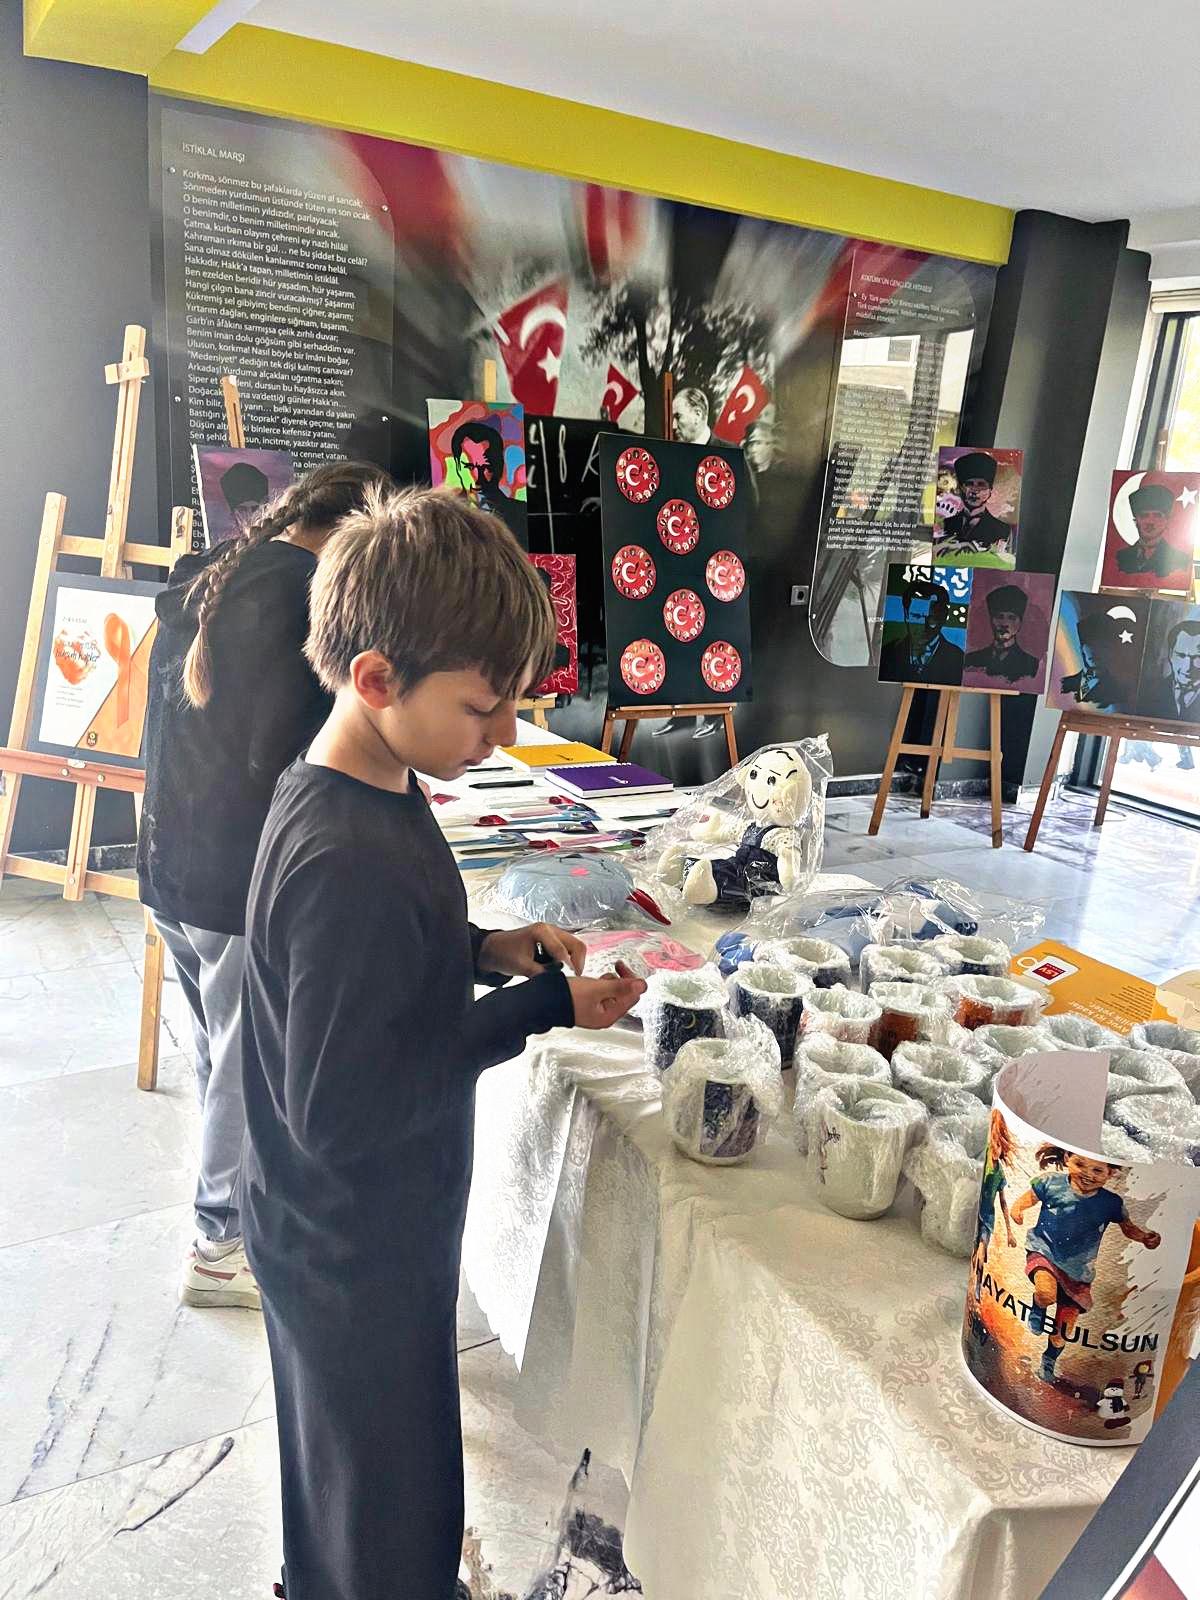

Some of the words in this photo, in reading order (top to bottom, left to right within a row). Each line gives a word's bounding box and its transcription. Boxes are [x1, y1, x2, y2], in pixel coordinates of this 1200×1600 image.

[183, 194, 190, 203] O
[192, 195, 218, 207] benim
[220, 201, 259, 214] milletimin
[184, 206, 191, 215] O
[240, 215, 264, 226] benim
[266, 220, 315, 234] milletimindir
[214, 223, 242, 235] kurban
[244, 228, 270, 240] olayım
[272, 233, 299, 244] çehreni
[301, 238, 310, 247] ey
[312, 240, 329, 248] nazlı
[184, 231, 225, 245] Kahraman
[227, 238, 251, 248] ırkıma
[254, 241, 264, 250] bir
[300, 248, 310, 257] bu
[312, 250, 334, 260] şiddet
[336, 253, 346, 262] bu
[184, 243, 204, 253] Sana
[206, 246, 230, 257] olmaz
[232, 249, 264, 262] dökülen
[266, 254, 304, 267] kanlarımız
[306, 262, 326, 270] sonra
[185, 267, 201, 277] Ben
[202, 271, 233, 281] ezelden
[235, 274, 261, 285] beridir
[263, 277, 276, 287] hür
[312, 284, 325, 293] hür
[221, 260, 248, 271] Hakk'a
[275, 269, 313, 280] milletimin
[185, 279, 209, 292] Hangi
[211, 283, 233, 294] çılgın
[234, 286, 253, 296] bana
[256, 289, 275, 298] zincir
[185, 291, 222, 306] Kükremiş
[224, 297, 235, 305] sel
[270, 302, 300, 313] bendimi
[186, 303, 217, 315] Yırtarım
[250, 313, 286, 323] enginlere
[186, 316, 214, 326] Garb'ın
[244, 324, 276, 334] sarmışsa
[278, 327, 295, 336] çelik
[296, 329, 314, 338] zırhlı
[187, 327, 212, 338] Benim
[236, 333, 253, 342] dolu
[255, 336, 286, 346] göğsüm
[287, 340, 301, 348] gibi
[303, 342, 341, 352] serhaddim
[252, 346, 270, 355] Nasıl
[271, 348, 292, 359] böyle
[294, 351, 304, 359] bir
[223, 366, 257, 377] Yurduma
[259, 370, 289, 380] alçakları
[291, 374, 322, 383] uğratma
[239, 356, 268, 368] dediğin
[270, 360, 282, 368] tek
[284, 361, 296, 371] dişi
[298, 363, 321, 374] kalmış
[188, 374, 208, 385] Siper
[255, 381, 281, 390] dursun
[283, 383, 292, 391] bu
[189, 397, 204, 406] Kim
[273, 404, 291, 413] belki
[293, 408, 323, 416] yarından
[325, 409, 334, 417] da
[287, 396, 311, 404] günler
[189, 408, 221, 419] Bastığın
[282, 416, 307, 426] diyerek
[190, 420, 214, 430] Düşün
[251, 425, 280, 434] binlerce
[282, 427, 311, 436] kefensiz
[190, 431, 205, 439] Sen
[206, 433, 226, 442] şehid
[293, 440, 318, 448] yazıktır
[975, 1261, 1033, 1322] HAYAT
[1040, 1317, 1160, 1353] BULSUN
